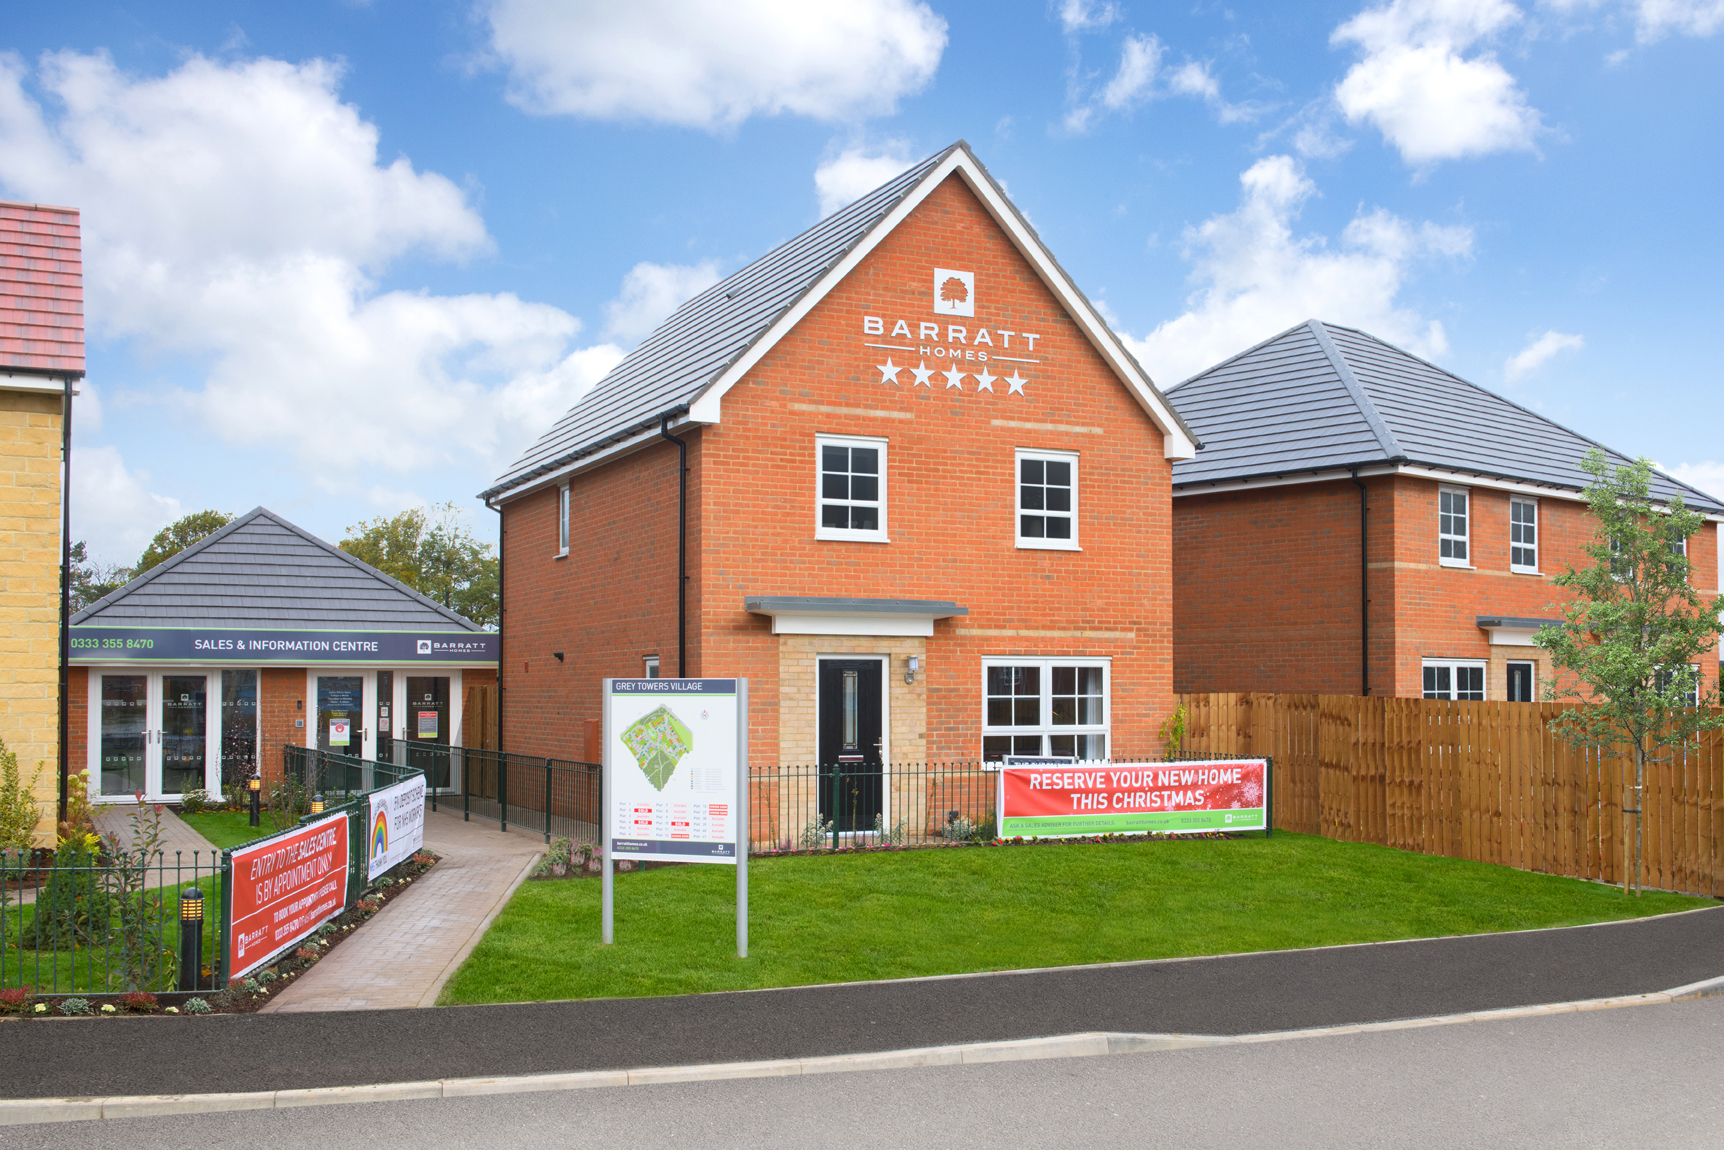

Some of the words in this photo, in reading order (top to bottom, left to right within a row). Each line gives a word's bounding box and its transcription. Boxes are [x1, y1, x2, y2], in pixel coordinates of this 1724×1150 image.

[864, 316, 1040, 351] BARRATT
[920, 346, 988, 362] HOMES
[70, 638, 100, 648] 0333
[102, 638, 124, 648] 355
[126, 639, 154, 649] 8470
[194, 640, 233, 650] SALES
[236, 640, 246, 650] &
[249, 640, 329, 651] INFORMATION
[332, 641, 378, 651] CENTRE
[616, 682, 635, 690] GREY
[637, 682, 669, 690] TOWERS
[670, 682, 702, 690] VILLAGE
[1030, 772, 1106, 790] RESERVE
[1110, 772, 1153, 788] YOUR
[1158, 770, 1194, 786] NEW
[1198, 768, 1241, 785] HOME
[1070, 793, 1108, 810] THIS
[1112, 790, 1204, 808] CHRISTMAS
[250, 851, 276, 880] ENTRY
[276, 849, 286, 870] TO
[285, 844, 300, 867] THE
[298, 836, 316, 860] SALES
[316, 827, 337, 853] CENTRE
[256, 883, 263, 905] IS
[264, 878, 274, 902] BY
[273, 858, 316, 897] APPOINTMENT
[318, 852, 332, 875] ONLY
[274, 912, 279, 924] TO
[279, 906, 289, 921] BOOK
[289, 902, 298, 915] YOUR
[245, 925, 268, 944] BARRATT
